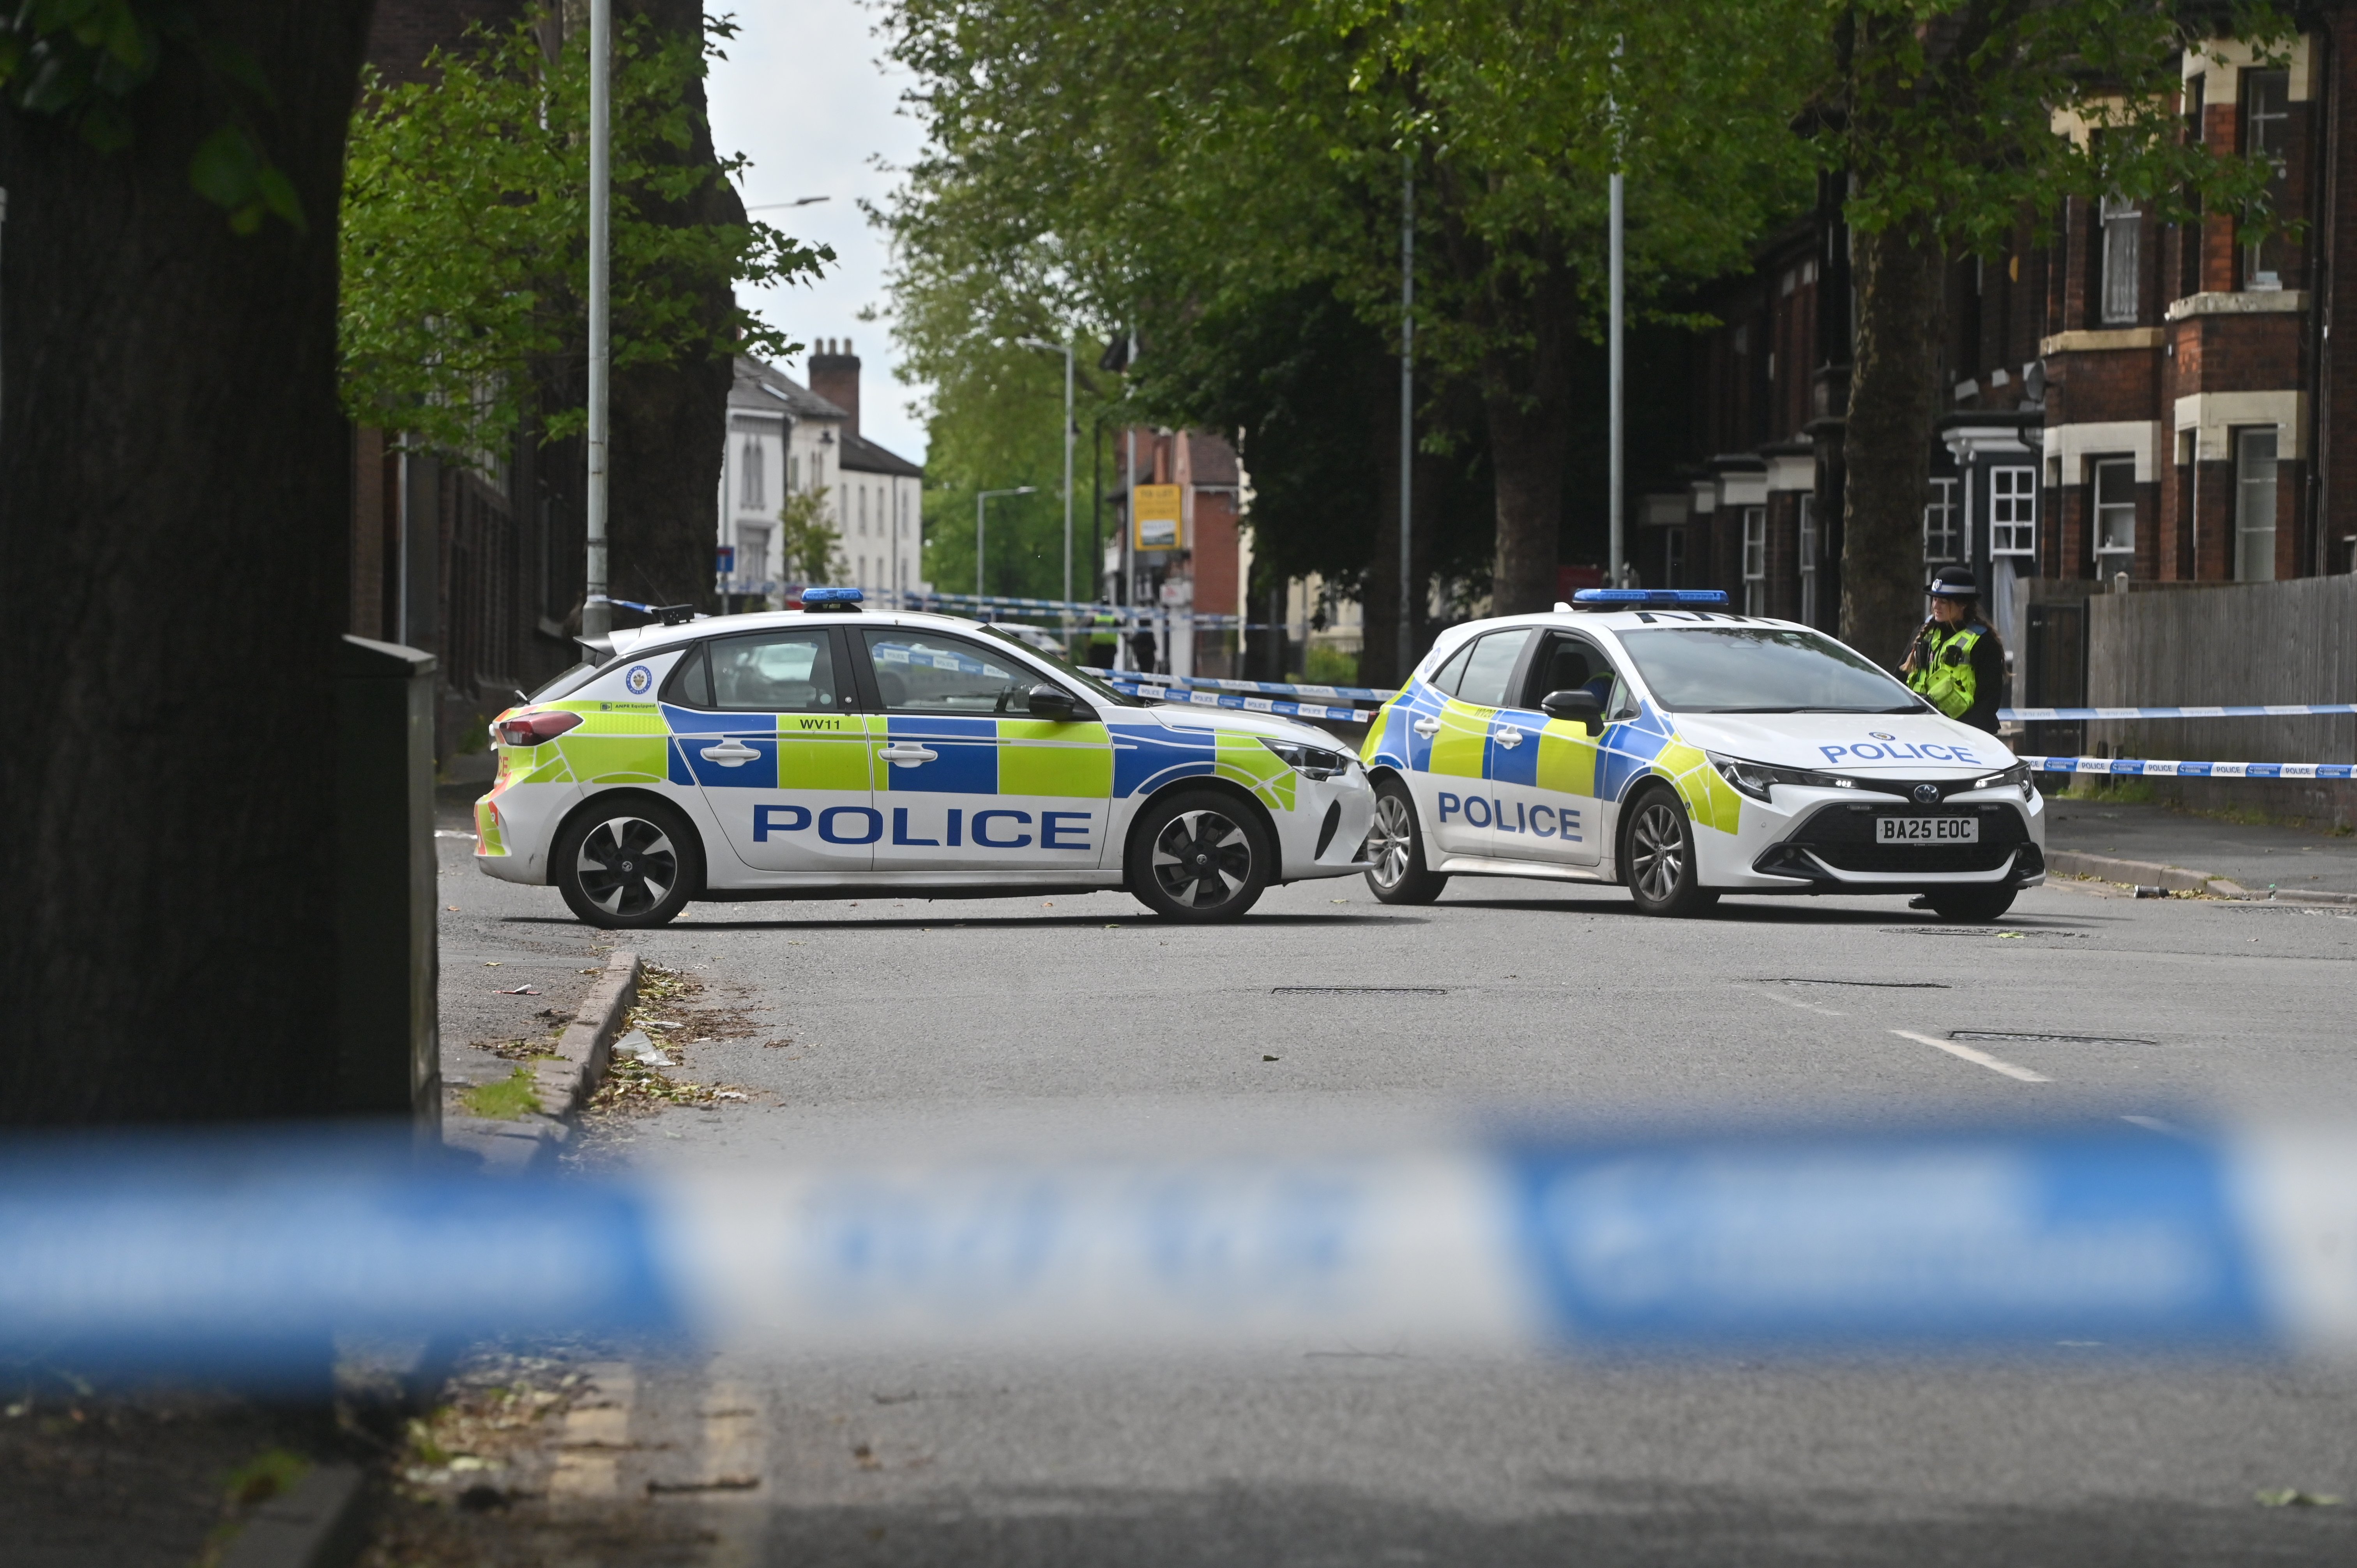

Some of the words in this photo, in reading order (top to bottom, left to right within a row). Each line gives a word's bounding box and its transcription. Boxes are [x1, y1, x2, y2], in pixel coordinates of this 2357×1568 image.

[1474, 708, 1497, 717] WV20
[800, 719, 840, 730] WV11
[1818, 743, 1982, 765] POLICE
[754, 804, 1091, 850] POLICE
[1438, 792, 1584, 842] POLICE
[1884, 820, 1931, 839] BA25
[1937, 820, 1971, 838] EOC
